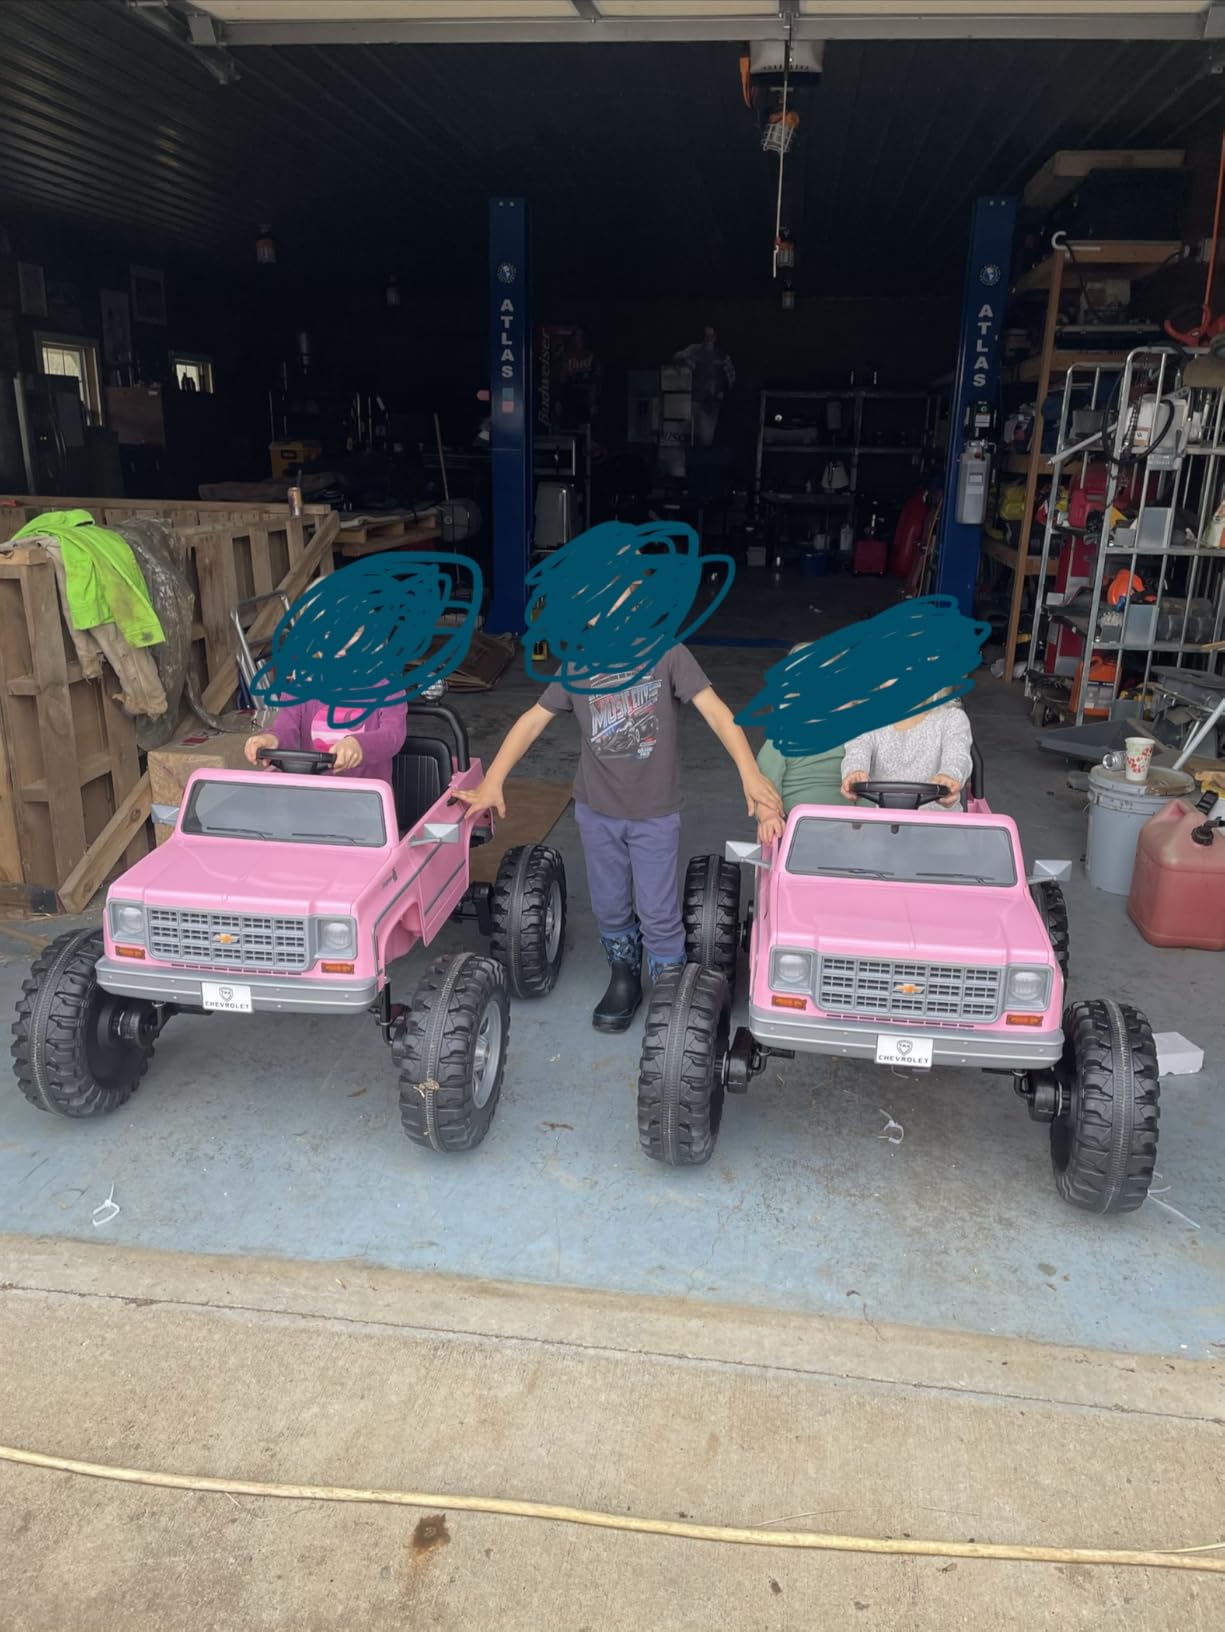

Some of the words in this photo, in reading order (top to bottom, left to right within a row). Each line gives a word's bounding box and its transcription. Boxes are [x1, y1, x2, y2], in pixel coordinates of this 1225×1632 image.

[500, 298, 515, 379] ATLAS
[972, 303, 993, 388] ATLAS
[205, 1001, 249, 1009] CHEVROLET
[878, 1054, 929, 1064] CHEVROLET
